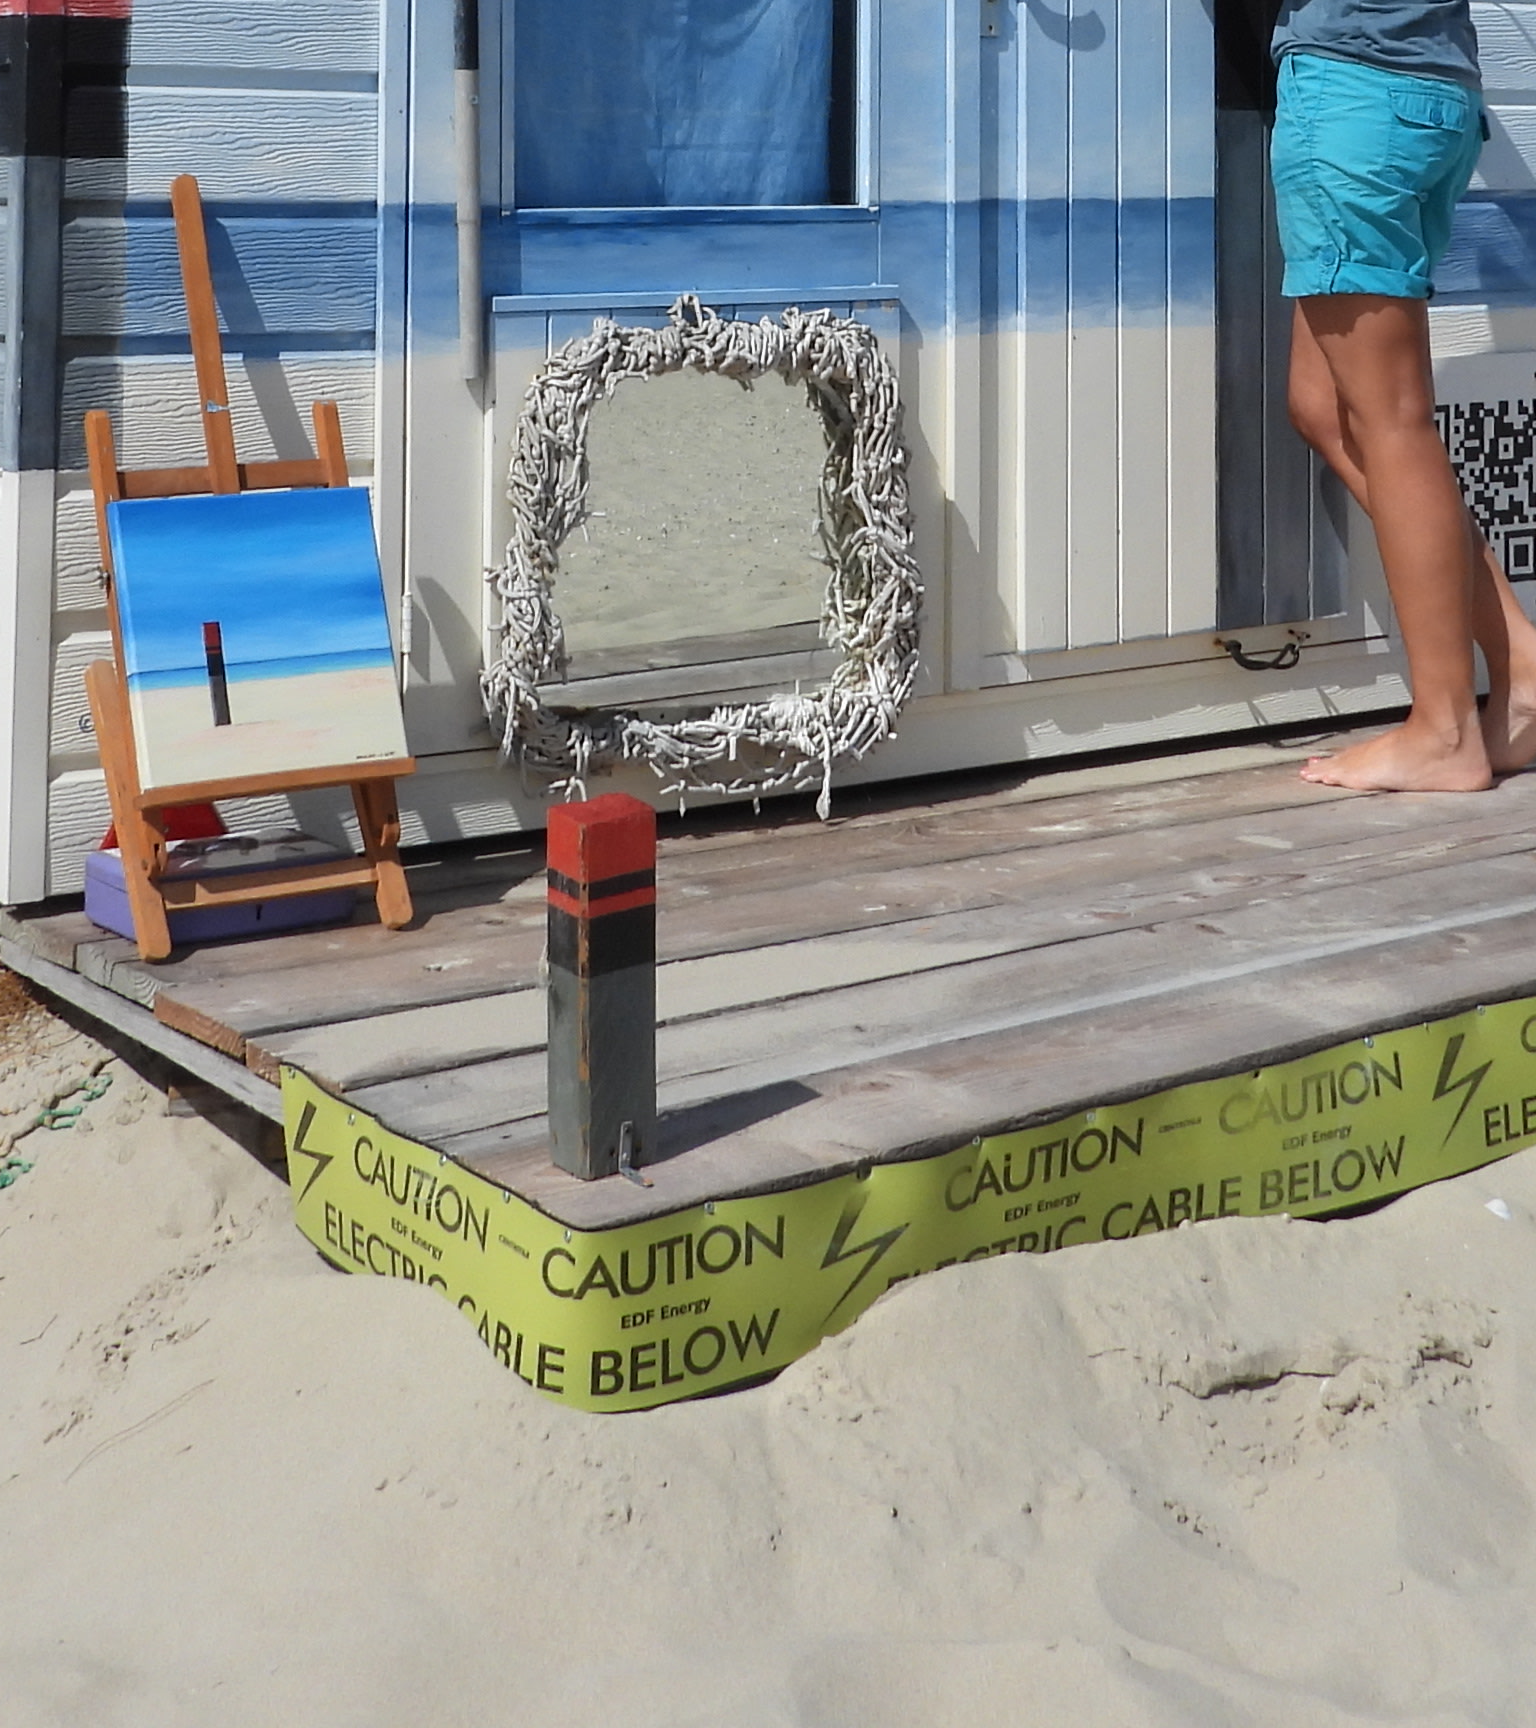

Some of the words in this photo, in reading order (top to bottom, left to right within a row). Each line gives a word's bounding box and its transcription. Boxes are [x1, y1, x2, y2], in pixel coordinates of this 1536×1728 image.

[1219, 1050, 1403, 1135] CAUTION
[1312, 1124, 1353, 1144] Energy
[354, 1135, 490, 1253] CAUTION
[945, 1118, 1144, 1213] CAUTION
[1005, 1203, 1033, 1222] EDF
[1037, 1192, 1081, 1213] Energy
[1101, 1176, 1243, 1240] CABLE
[1260, 1134, 1406, 1211] BELOW
[412, 1230, 444, 1262] Energy
[541, 1215, 785, 1300] CAUTION
[591, 1308, 780, 1397] BELOW
[621, 1306, 655, 1330] EDF
[660, 1296, 711, 1322] Energy
